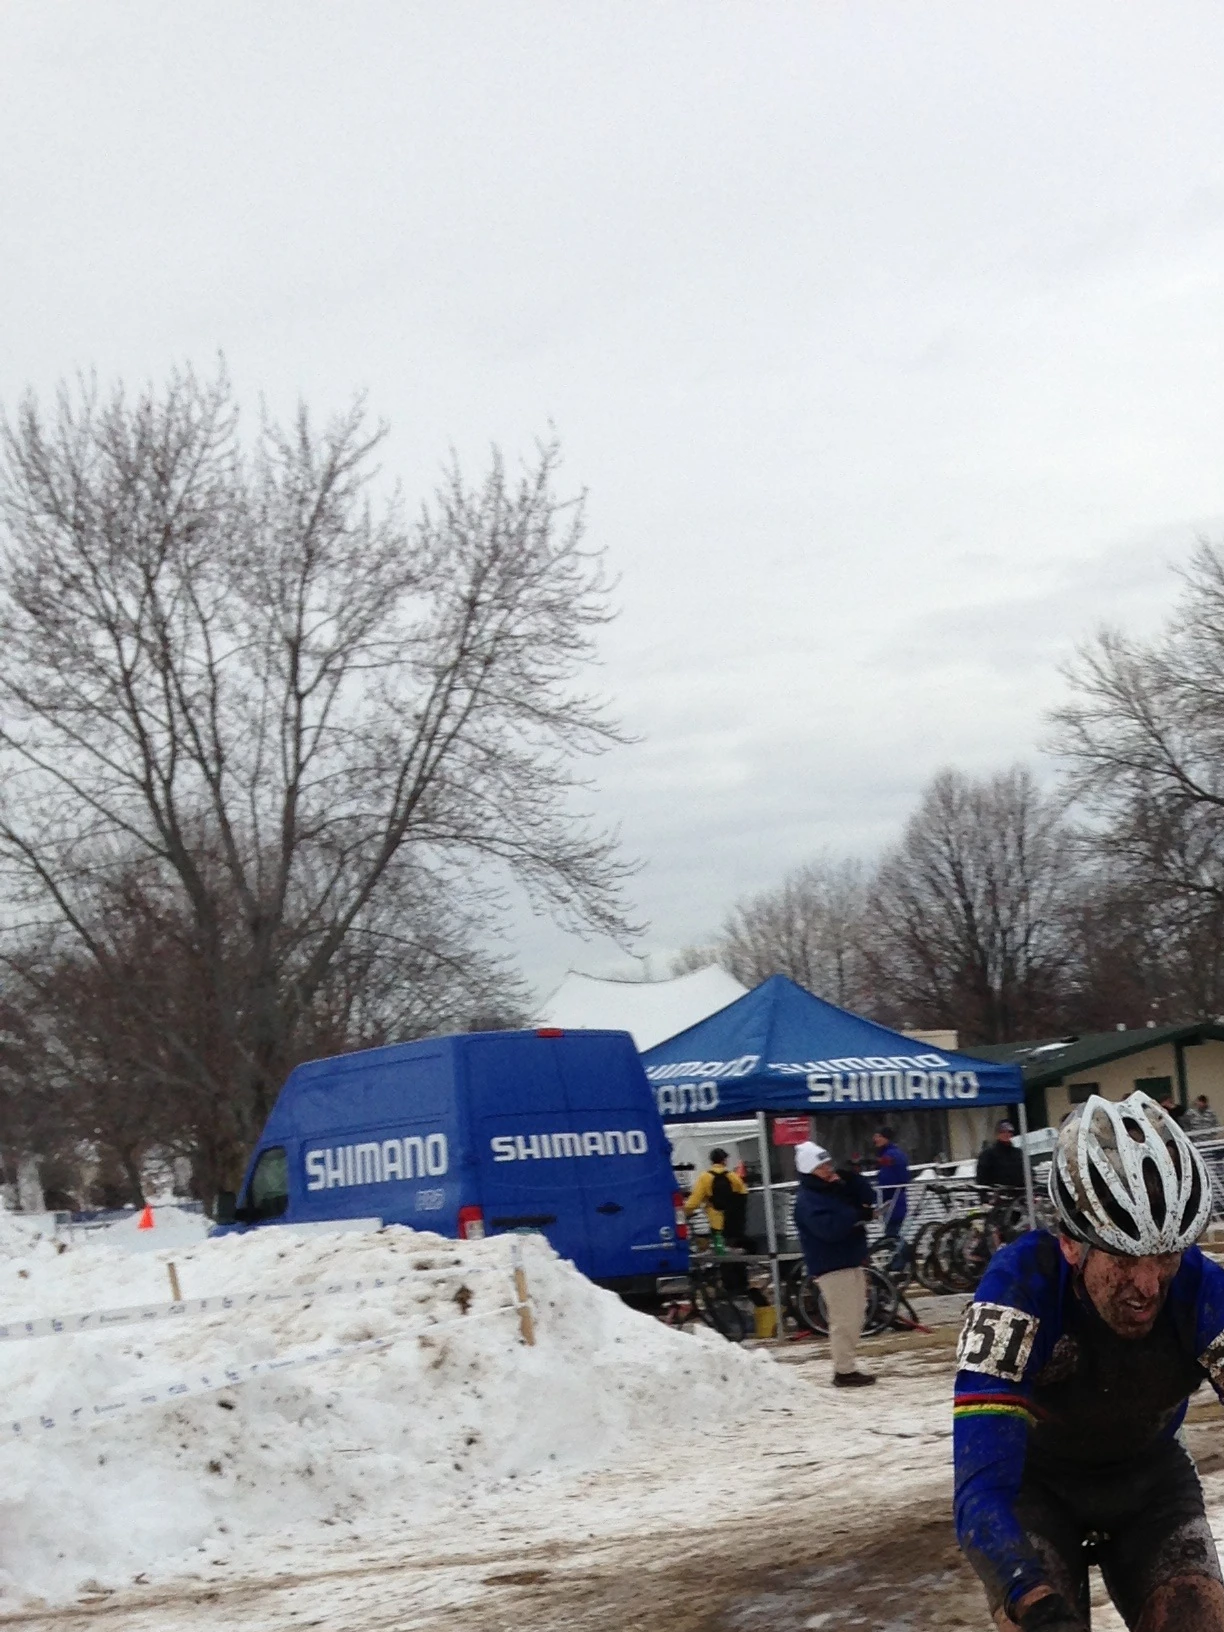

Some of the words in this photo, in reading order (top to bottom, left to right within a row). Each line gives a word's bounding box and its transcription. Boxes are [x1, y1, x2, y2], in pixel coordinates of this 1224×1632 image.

[767, 1053, 950, 1075] SHIMANO
[806, 1070, 979, 1103] SHIMANO
[305, 1132, 449, 1191] SHIMANO
[490, 1130, 648, 1162] SHIMANO
[961, 1307, 1029, 1374] 51
